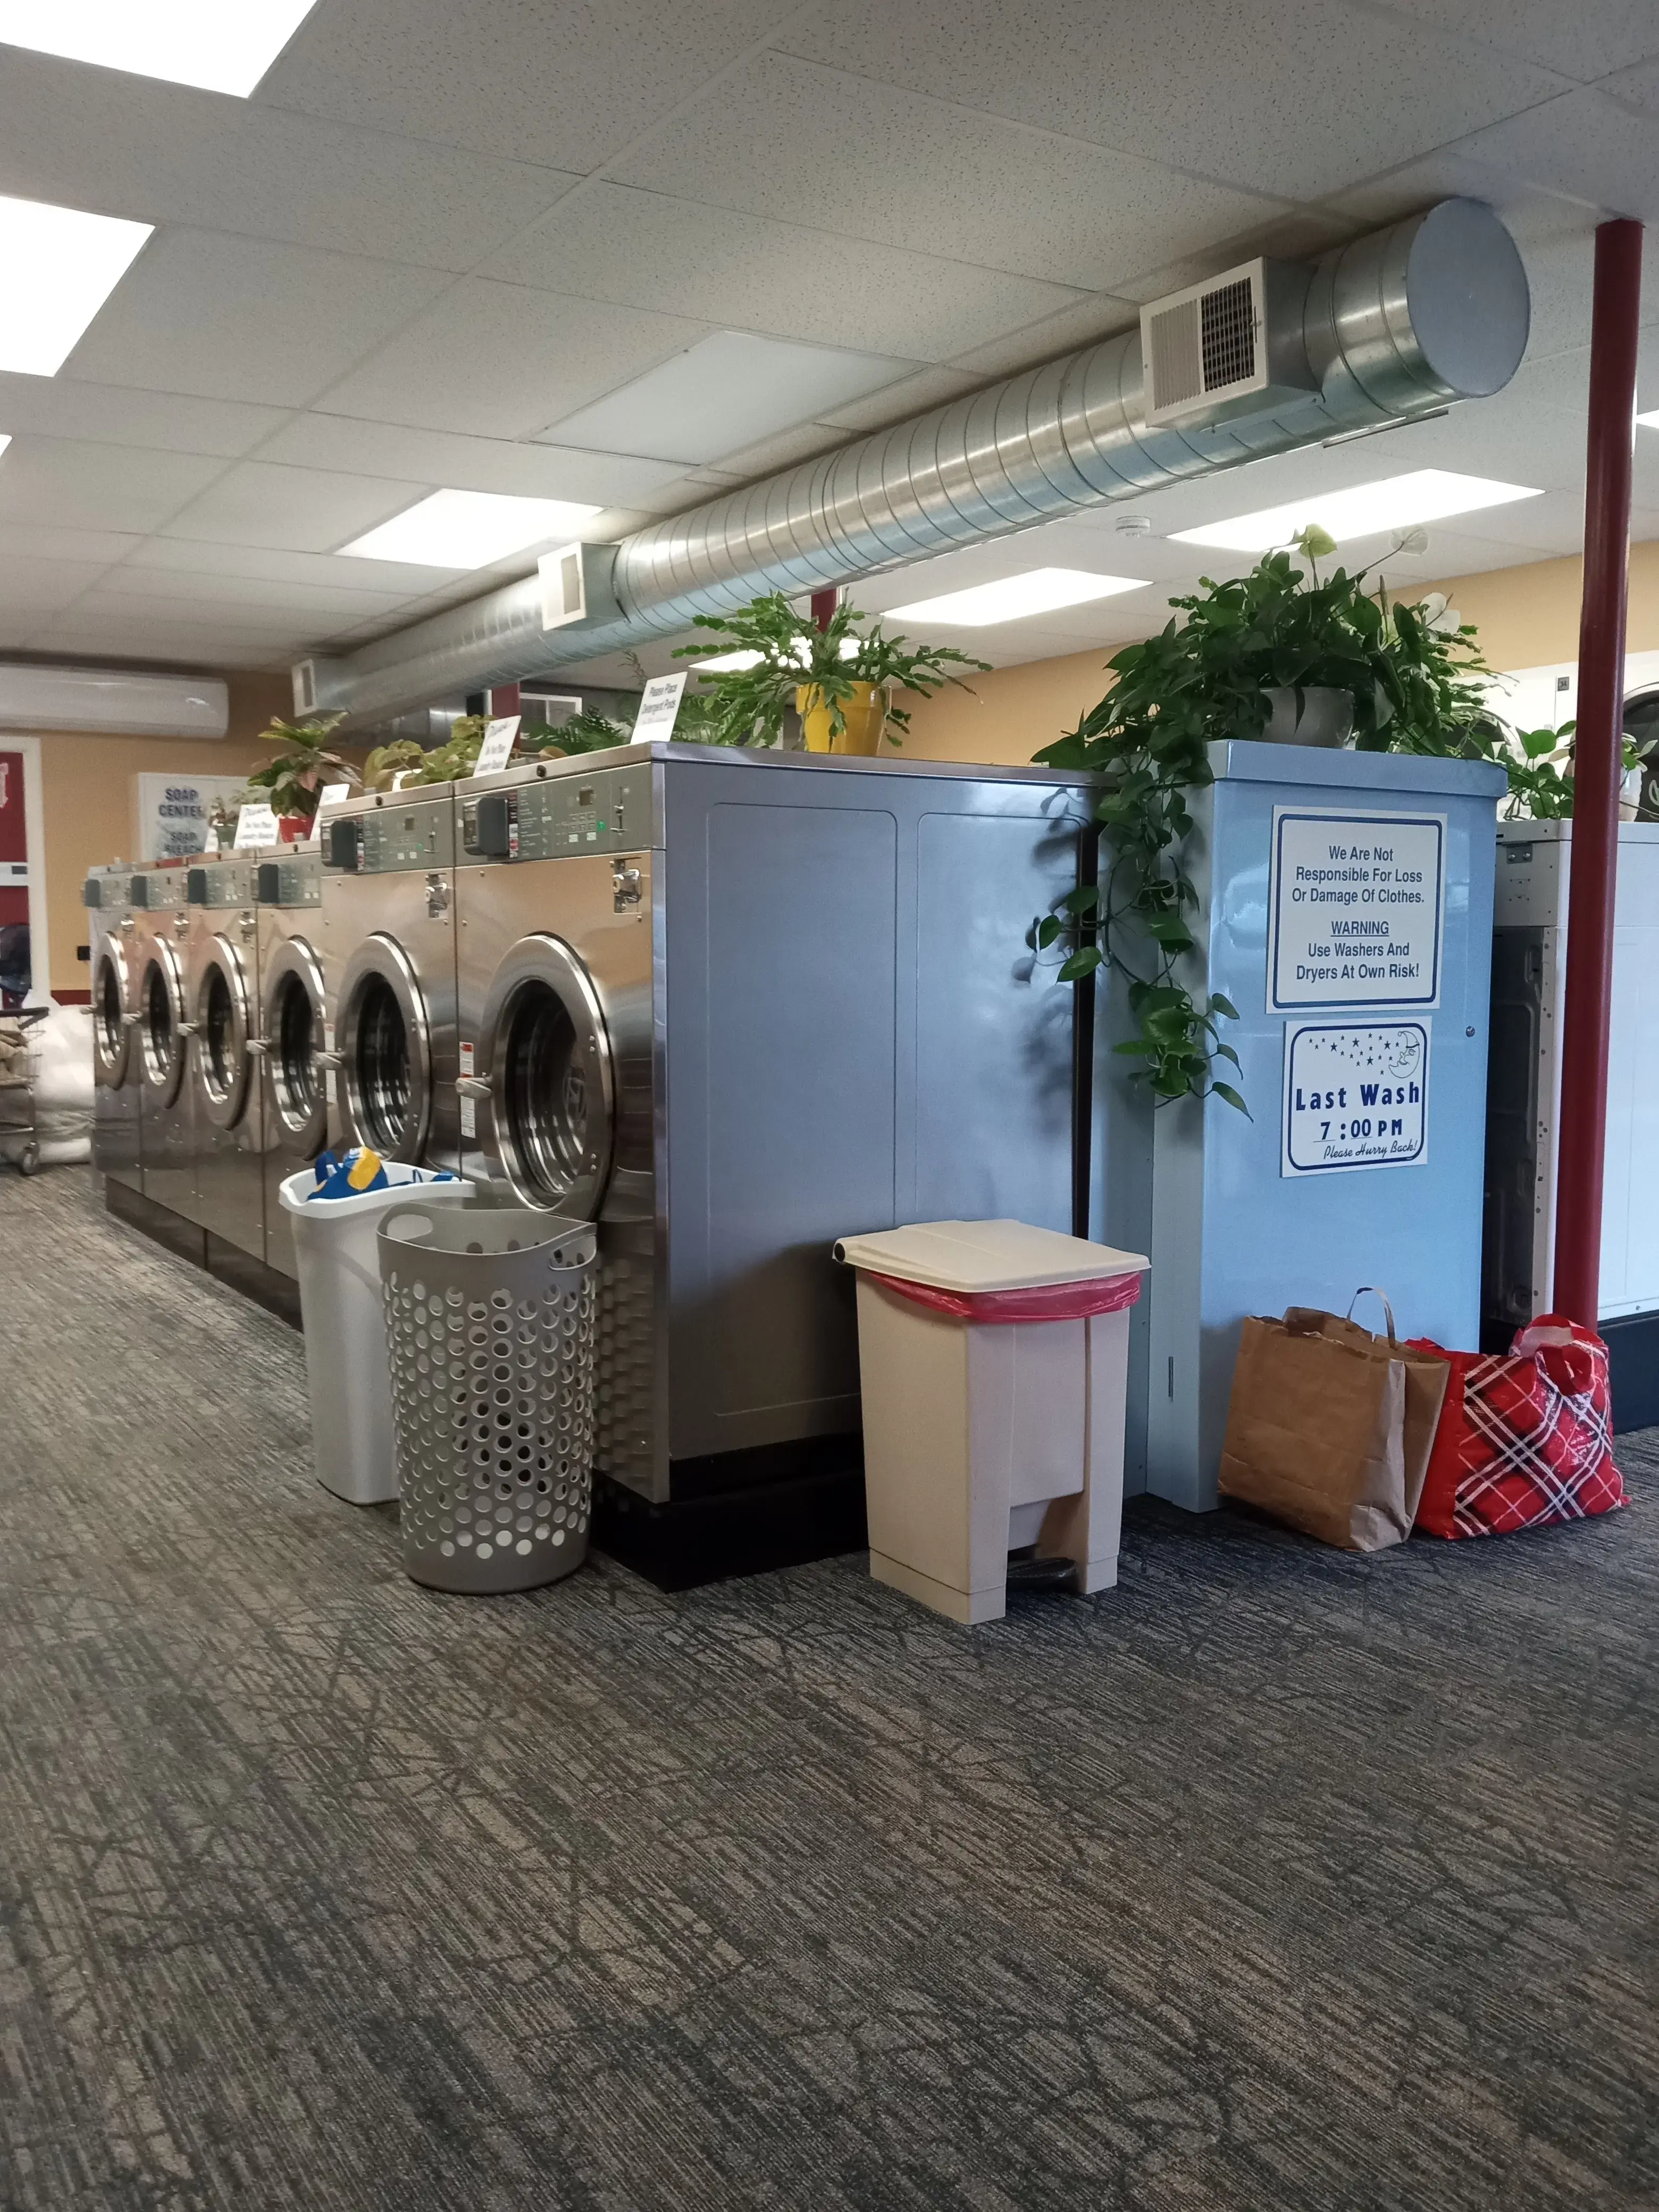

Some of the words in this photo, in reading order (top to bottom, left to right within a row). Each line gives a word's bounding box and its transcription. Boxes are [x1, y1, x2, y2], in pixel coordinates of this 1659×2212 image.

[165, 788, 199, 802] SOAP
[1328, 845, 1347, 860] We
[1350, 846, 1370, 861] Are
[1373, 847, 1394, 861] Not
[1296, 866, 1369, 884] Responsible
[1373, 868, 1392, 882] For
[1395, 869, 1423, 883] Loss
[1292, 887, 1307, 902] Or
[1310, 888, 1358, 906] Damage
[1361, 889, 1376, 903] Of
[1378, 889, 1425, 903] Clothes.
[1331, 921, 1389, 935] WARNING
[1308, 943, 1331, 957] Use
[1335, 942, 1384, 957] Washers
[1387, 942, 1410, 956] And
[1296, 965, 1338, 984] Dryers
[1341, 964, 1355, 979] At
[1358, 963, 1385, 978] Own
[1389, 963, 1420, 978] Risk!
[1295, 1087, 1347, 1111] Last
[1360, 1082, 1419, 1107] Wash
[1323, 1145, 1353, 1160] Please
[1355, 1142, 1388, 1158] Hurry
[1390, 1138, 1418, 1153] Back!
